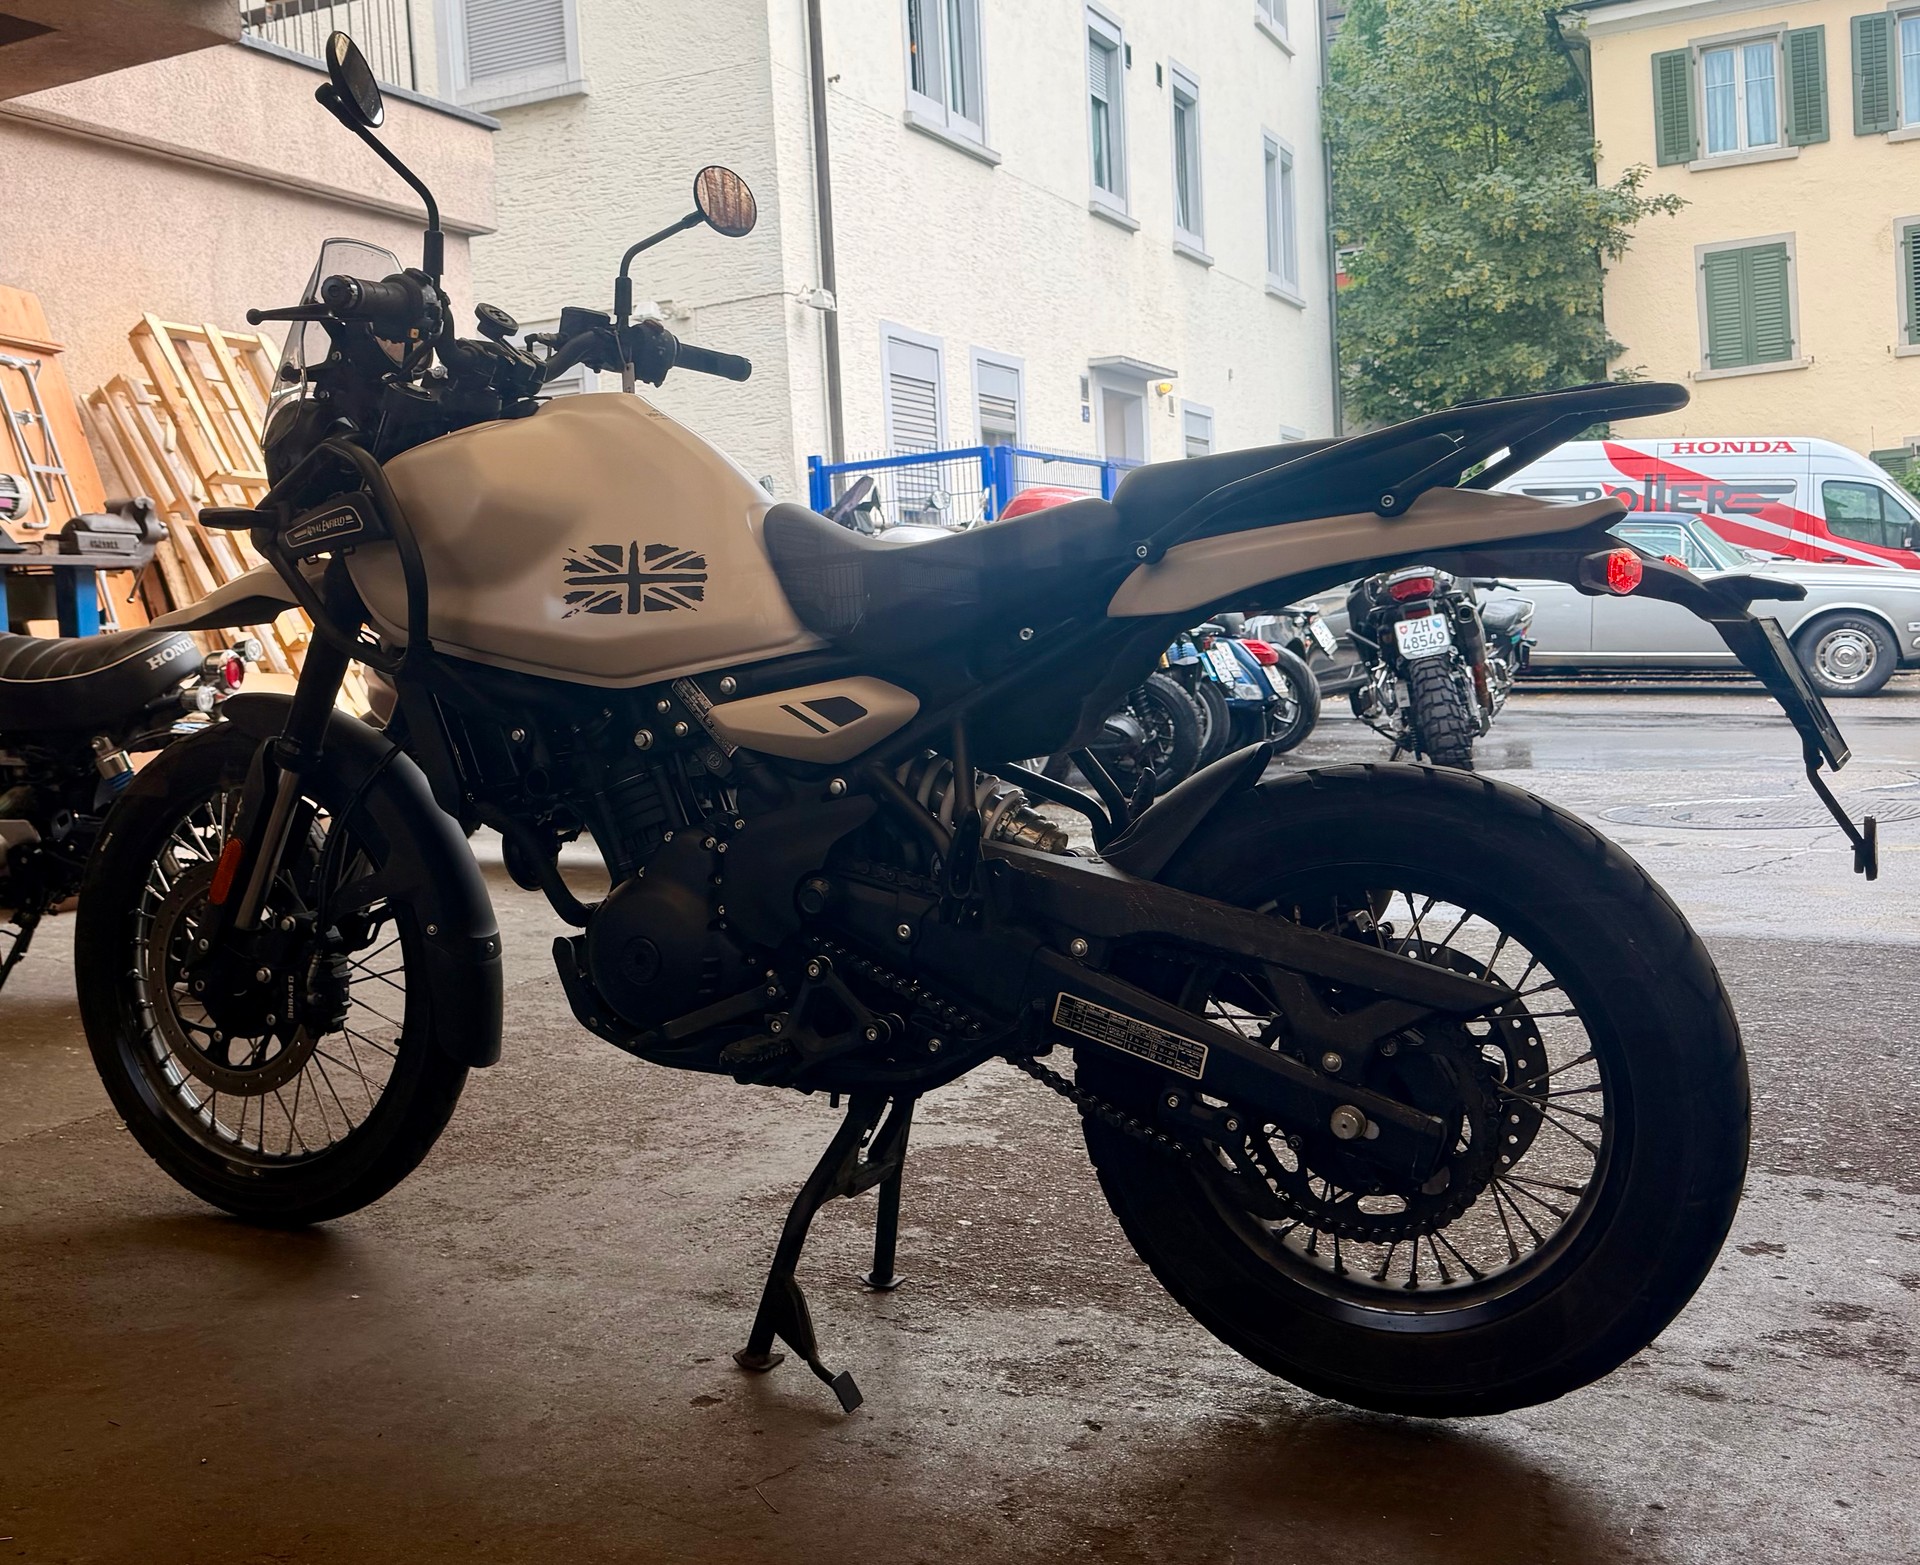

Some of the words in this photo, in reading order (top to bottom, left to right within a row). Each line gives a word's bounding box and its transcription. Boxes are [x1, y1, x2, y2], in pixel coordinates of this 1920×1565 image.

[1671, 441, 1797, 454] HONDA
[1410, 619, 1431, 634] ZH
[1403, 631, 1445, 651] 48549
